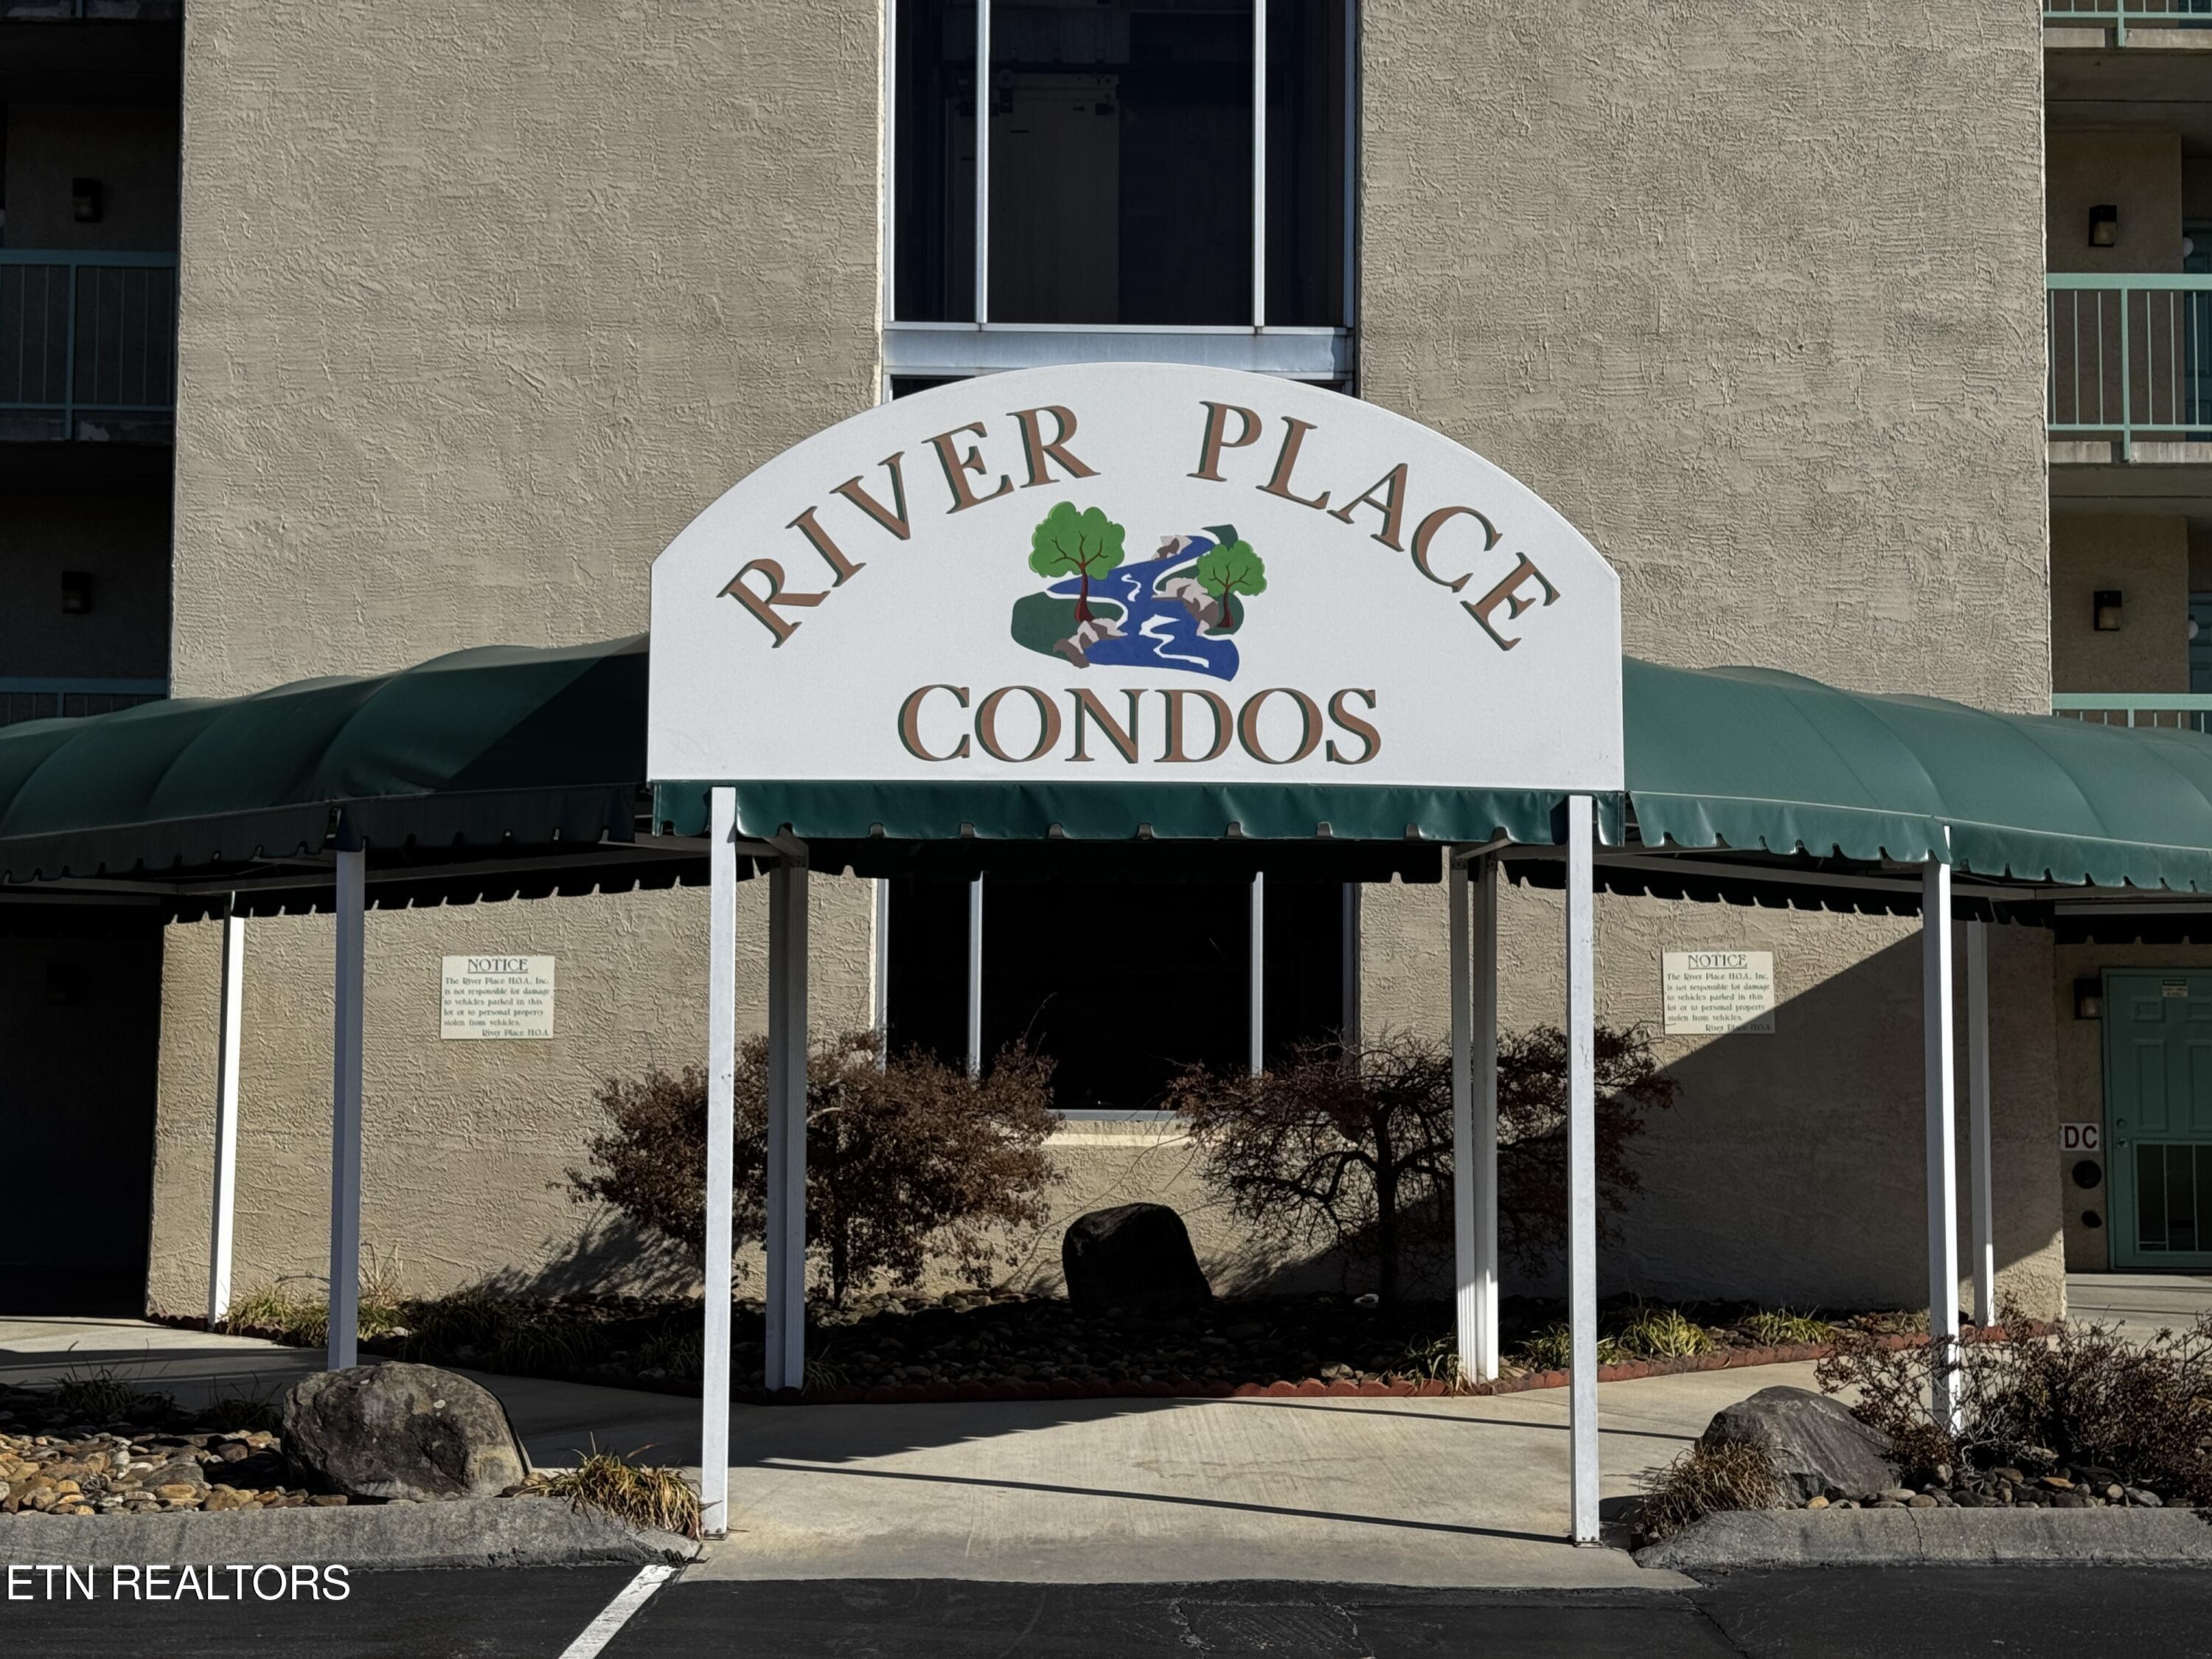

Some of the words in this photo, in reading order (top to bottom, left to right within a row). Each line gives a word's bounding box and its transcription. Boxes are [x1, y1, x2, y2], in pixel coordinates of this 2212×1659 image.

[716, 404, 1101, 650] RIVER
[1186, 400, 1561, 652] PLACE
[897, 683, 1382, 765] CONDOS
[467, 959, 529, 971] NOTICE
[1688, 955, 1747, 967] NOTICE
[462, 977, 481, 985] River
[468, 988, 507, 997] responsible
[523, 987, 550, 995] damage
[1690, 984, 1728, 992] responsible
[1744, 983, 1770, 991] damage
[1710, 993, 1734, 1001] parked
[488, 998, 513, 1006] parked
[1702, 1004, 1732, 1012] personal
[1736, 1004, 1764, 1012] property
[479, 1009, 510, 1017] personal
[2059, 1125, 2097, 1149] DC
